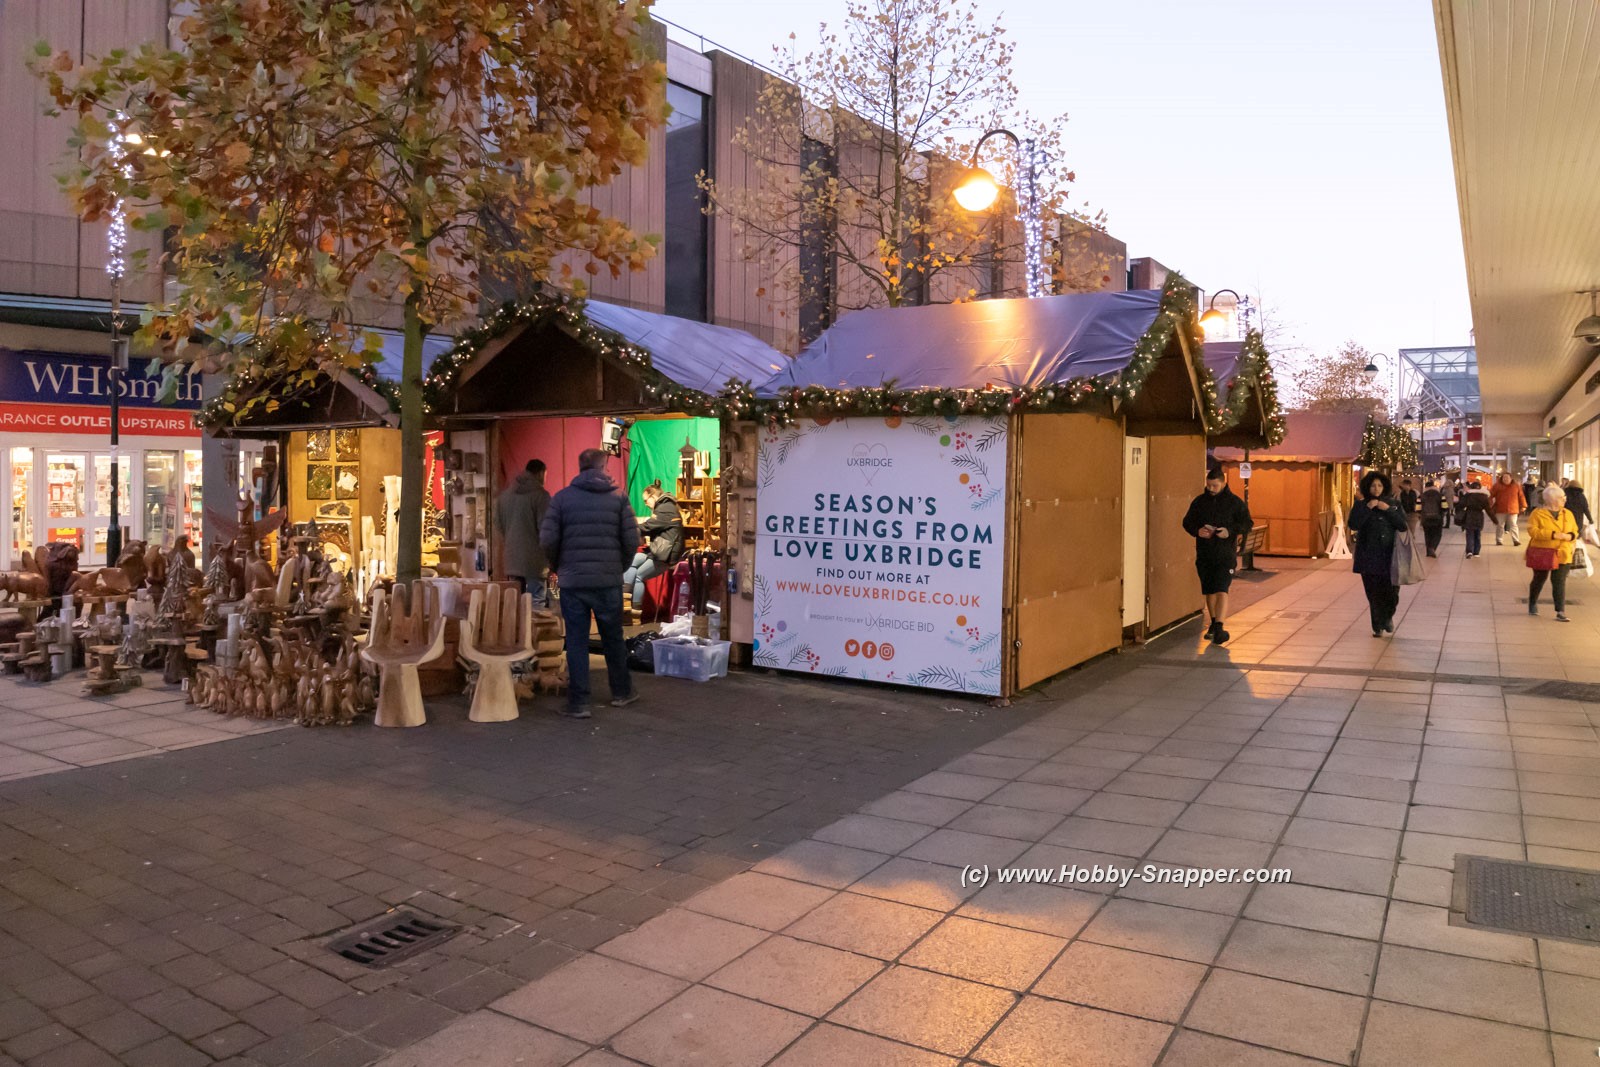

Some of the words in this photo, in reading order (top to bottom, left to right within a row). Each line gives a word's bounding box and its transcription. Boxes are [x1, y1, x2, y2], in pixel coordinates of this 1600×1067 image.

[120, 417, 186, 430] UPSTAIRS
[846, 457, 893, 468] UXBRIDGE
[814, 493, 937, 516] SEASON'S
[765, 515, 903, 540] GREETINGS
[916, 521, 993, 544] FROM
[773, 539, 834, 561] LOVE
[845, 543, 982, 570] UXBRIDGE
[816, 567, 845, 579] FIND
[848, 570, 872, 582] OUT
[876, 572, 912, 584] MORE
[916, 574, 931, 585] AT
[776, 580, 981, 608] WWW.LOVEUXBRIDGE.CO.UK
[865, 612, 915, 632] UXBRIDGE
[917, 621, 935, 633] BID
